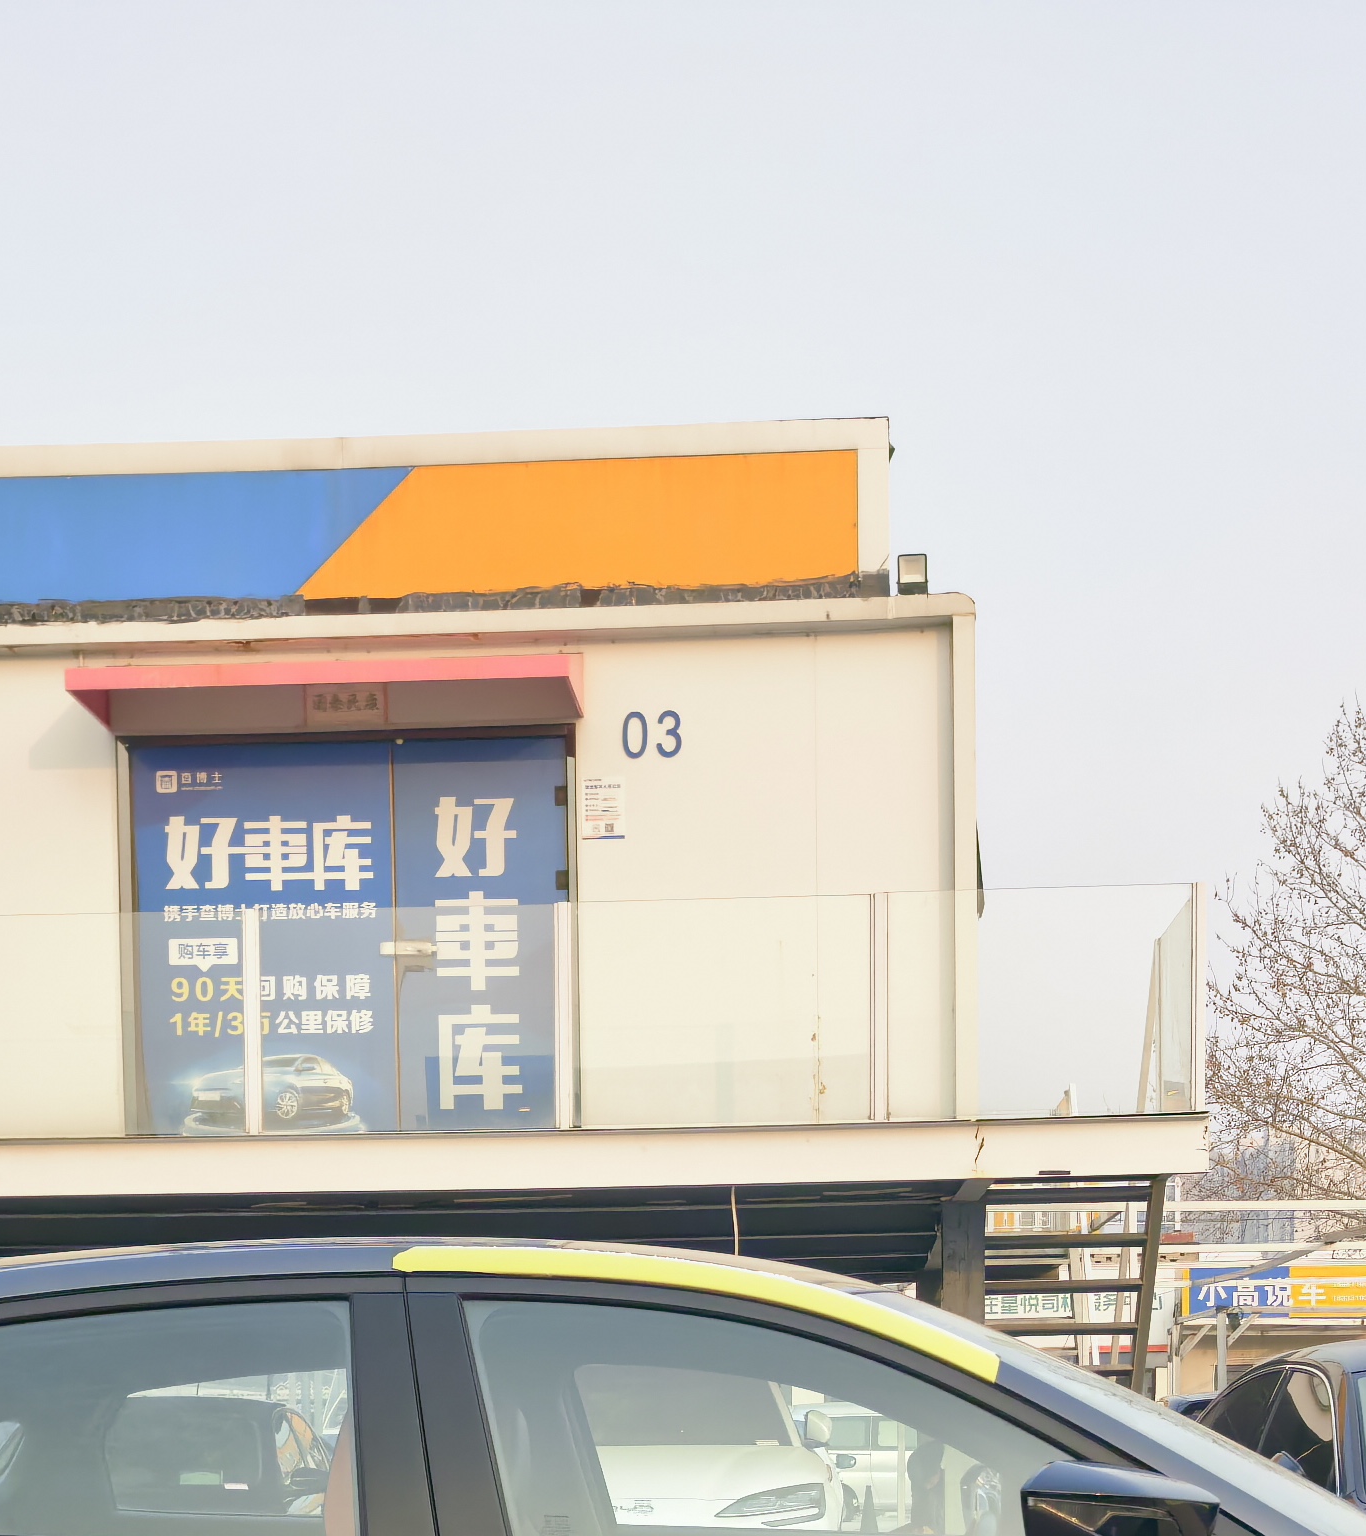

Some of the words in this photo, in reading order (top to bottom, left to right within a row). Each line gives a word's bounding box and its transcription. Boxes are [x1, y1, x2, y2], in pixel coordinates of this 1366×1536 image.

[622, 710, 682, 759] 03
[178, 943, 230, 960] 购车享
[1197, 1277, 1327, 1308] 小高说车
